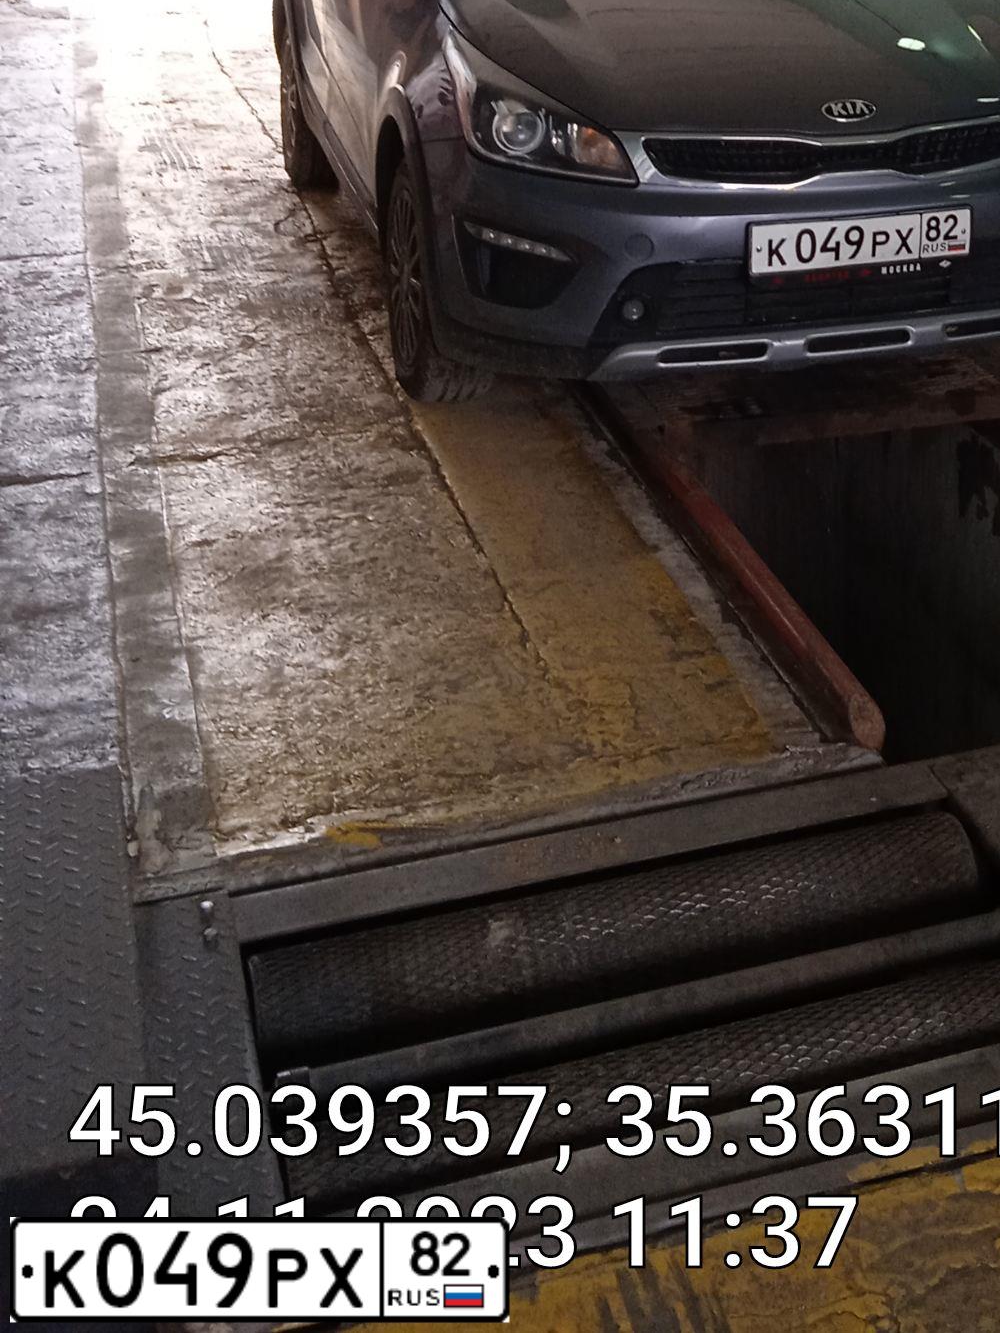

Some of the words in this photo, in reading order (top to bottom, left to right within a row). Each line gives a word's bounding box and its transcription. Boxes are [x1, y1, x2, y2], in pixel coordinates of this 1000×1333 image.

[829, 101, 870, 118] KIA
[925, 214, 958, 242] 82
[922, 242, 947, 254] RUS
[881, 263, 921, 275] МОСКВА
